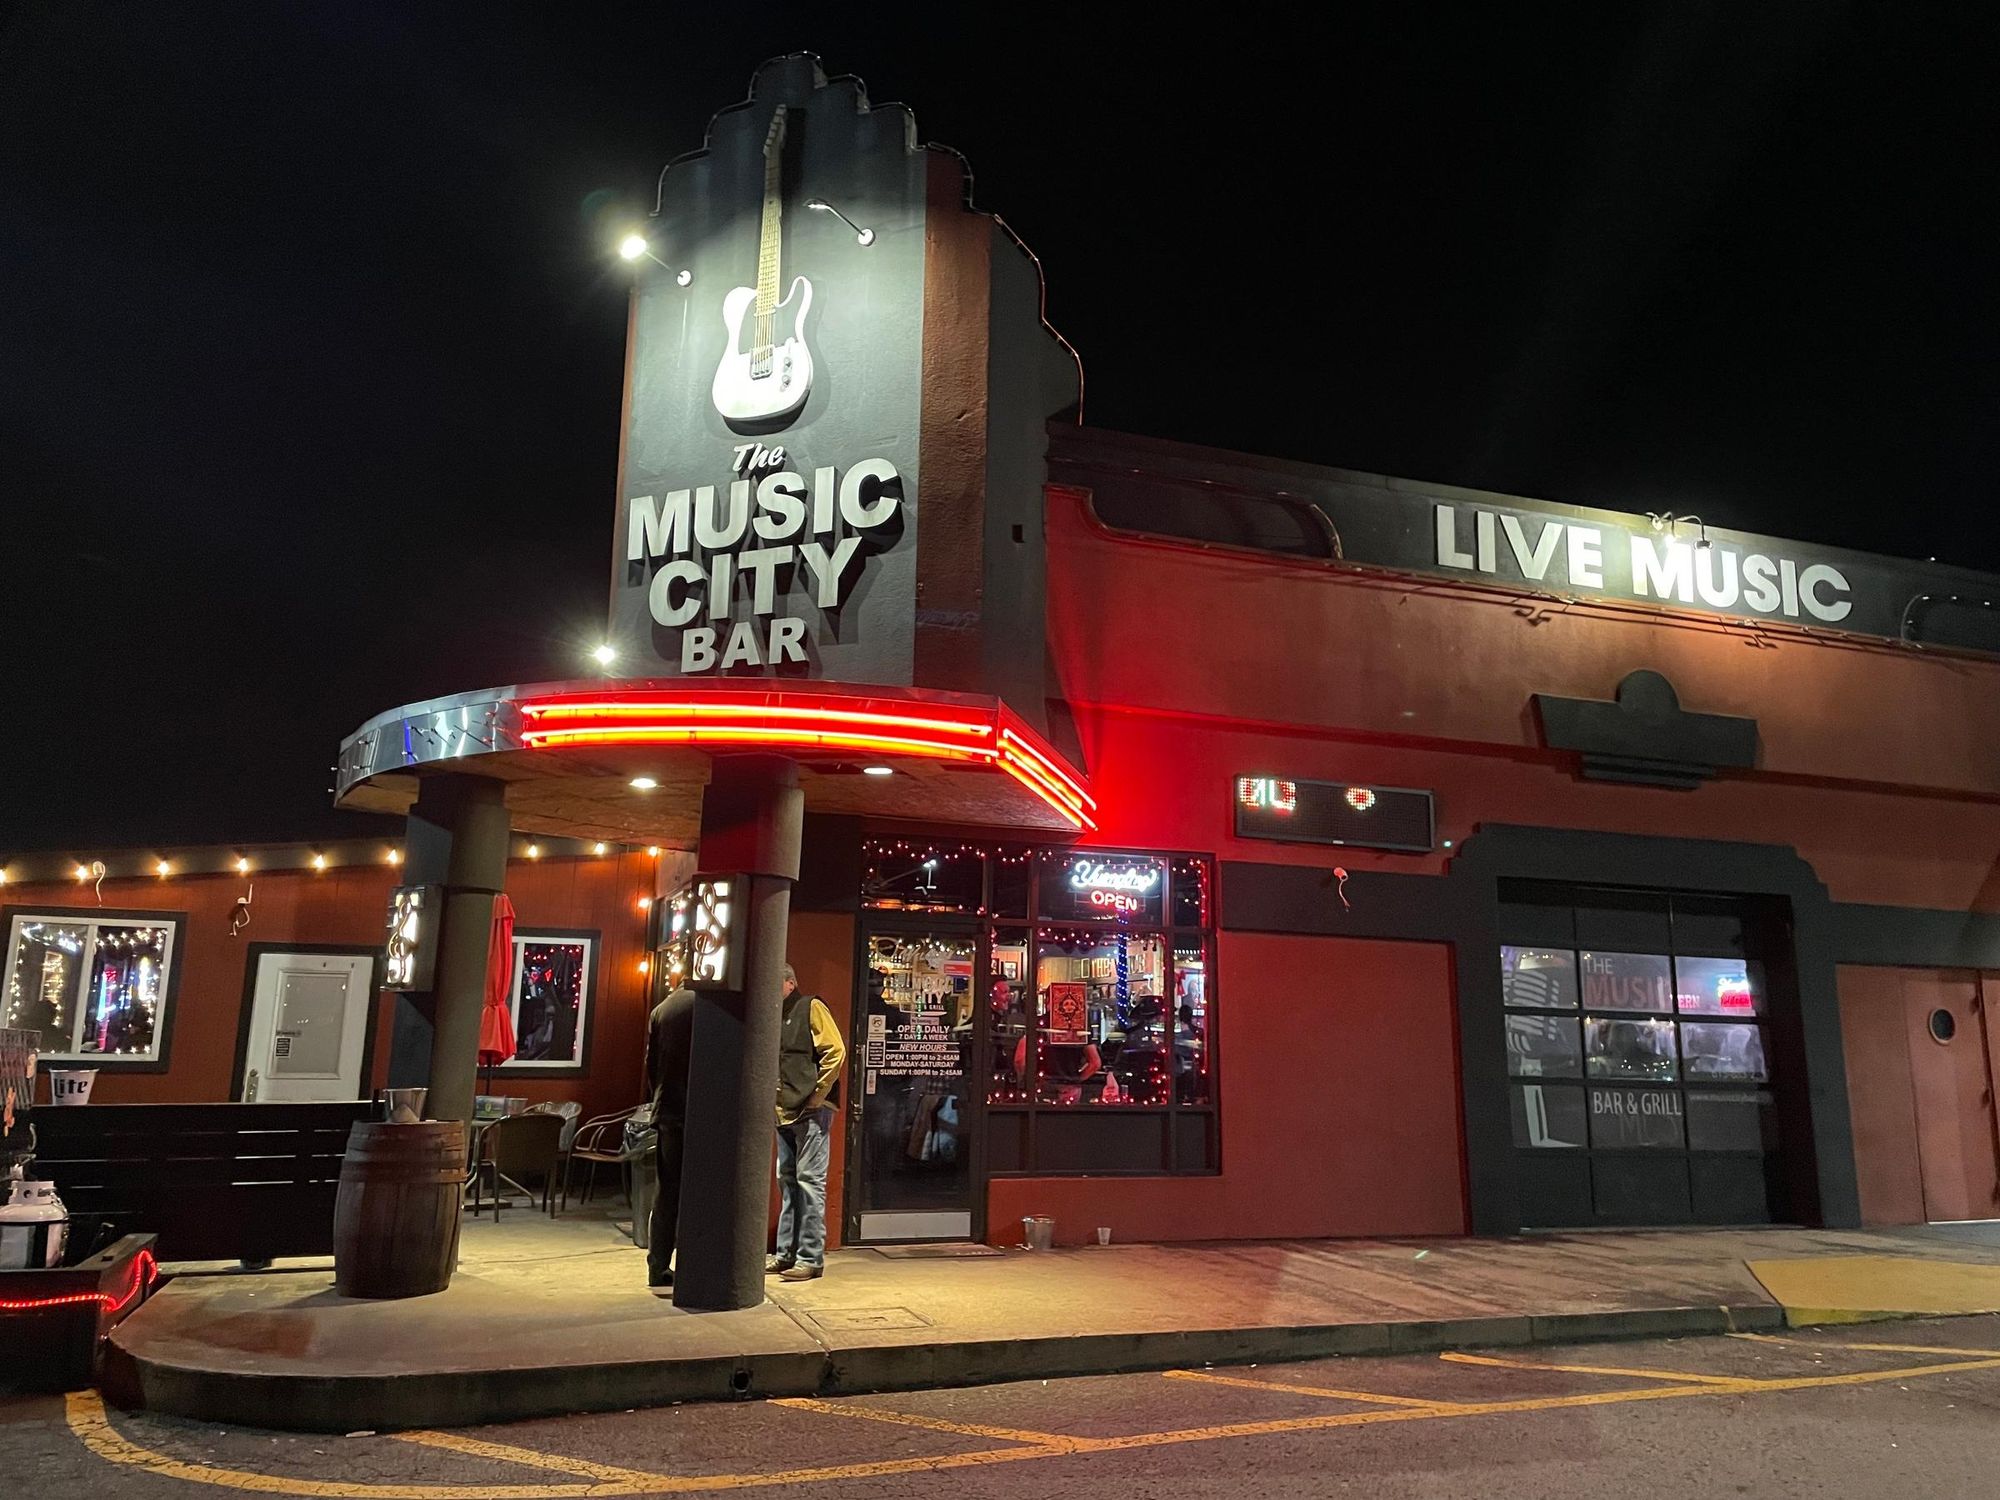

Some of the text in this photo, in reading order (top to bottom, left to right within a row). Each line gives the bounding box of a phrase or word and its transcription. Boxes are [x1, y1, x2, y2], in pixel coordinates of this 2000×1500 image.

[733, 443, 785, 472] The
[627, 458, 900, 561] MUSIC
[1436, 504, 1853, 622] LIVE MUSIC
[649, 536, 863, 627] CITY
[680, 617, 809, 673] BAR
[1091, 890, 1138, 911] OPEN
[1585, 957, 1615, 974] THE
[924, 1025, 950, 1034] DAILY
[900, 1043, 947, 1052] NEW HOURS
[54, 1079, 88, 1098] Lite
[1593, 1091, 1623, 1115] BAR
[1626, 1092, 1638, 1115] &
[1641, 1092, 1682, 1116] GRILL
